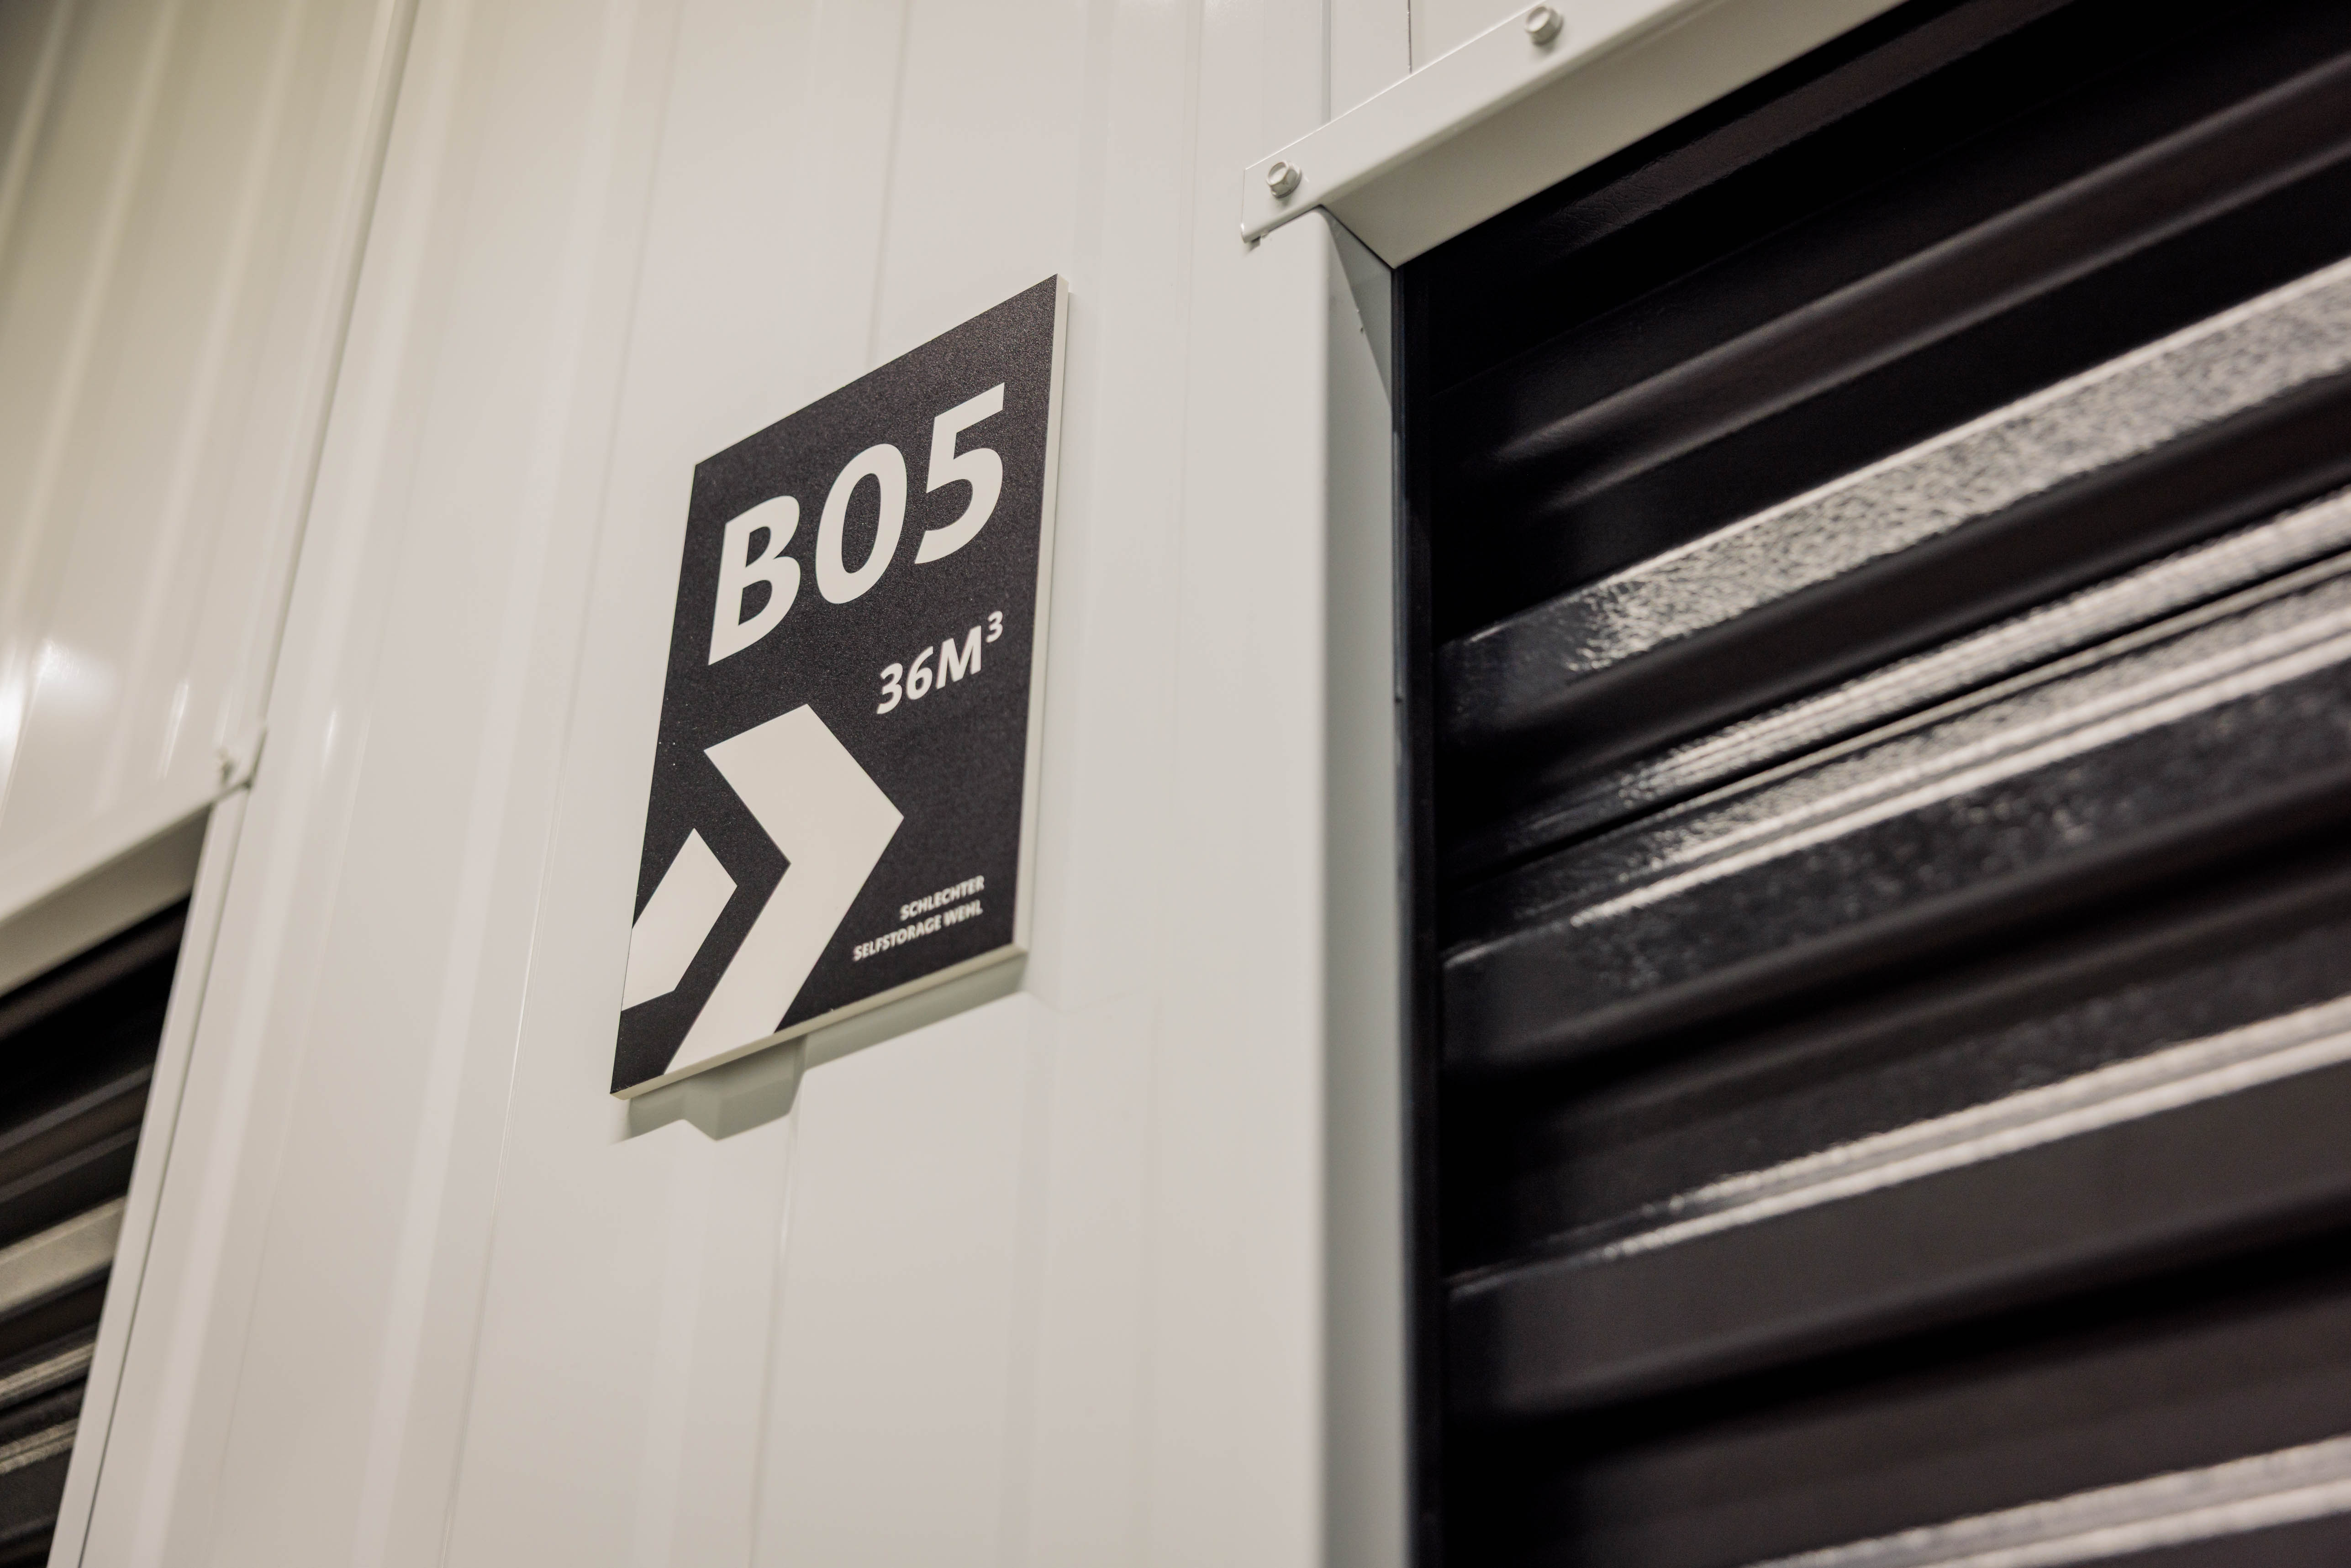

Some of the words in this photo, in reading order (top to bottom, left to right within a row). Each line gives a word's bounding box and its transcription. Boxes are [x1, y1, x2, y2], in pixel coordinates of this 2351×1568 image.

[708, 382, 1005, 666] B05
[900, 875, 985, 921] SCHLECHTER
[853, 915, 942, 961] SELFSTORAGE
[943, 899, 983, 926] WEHL
